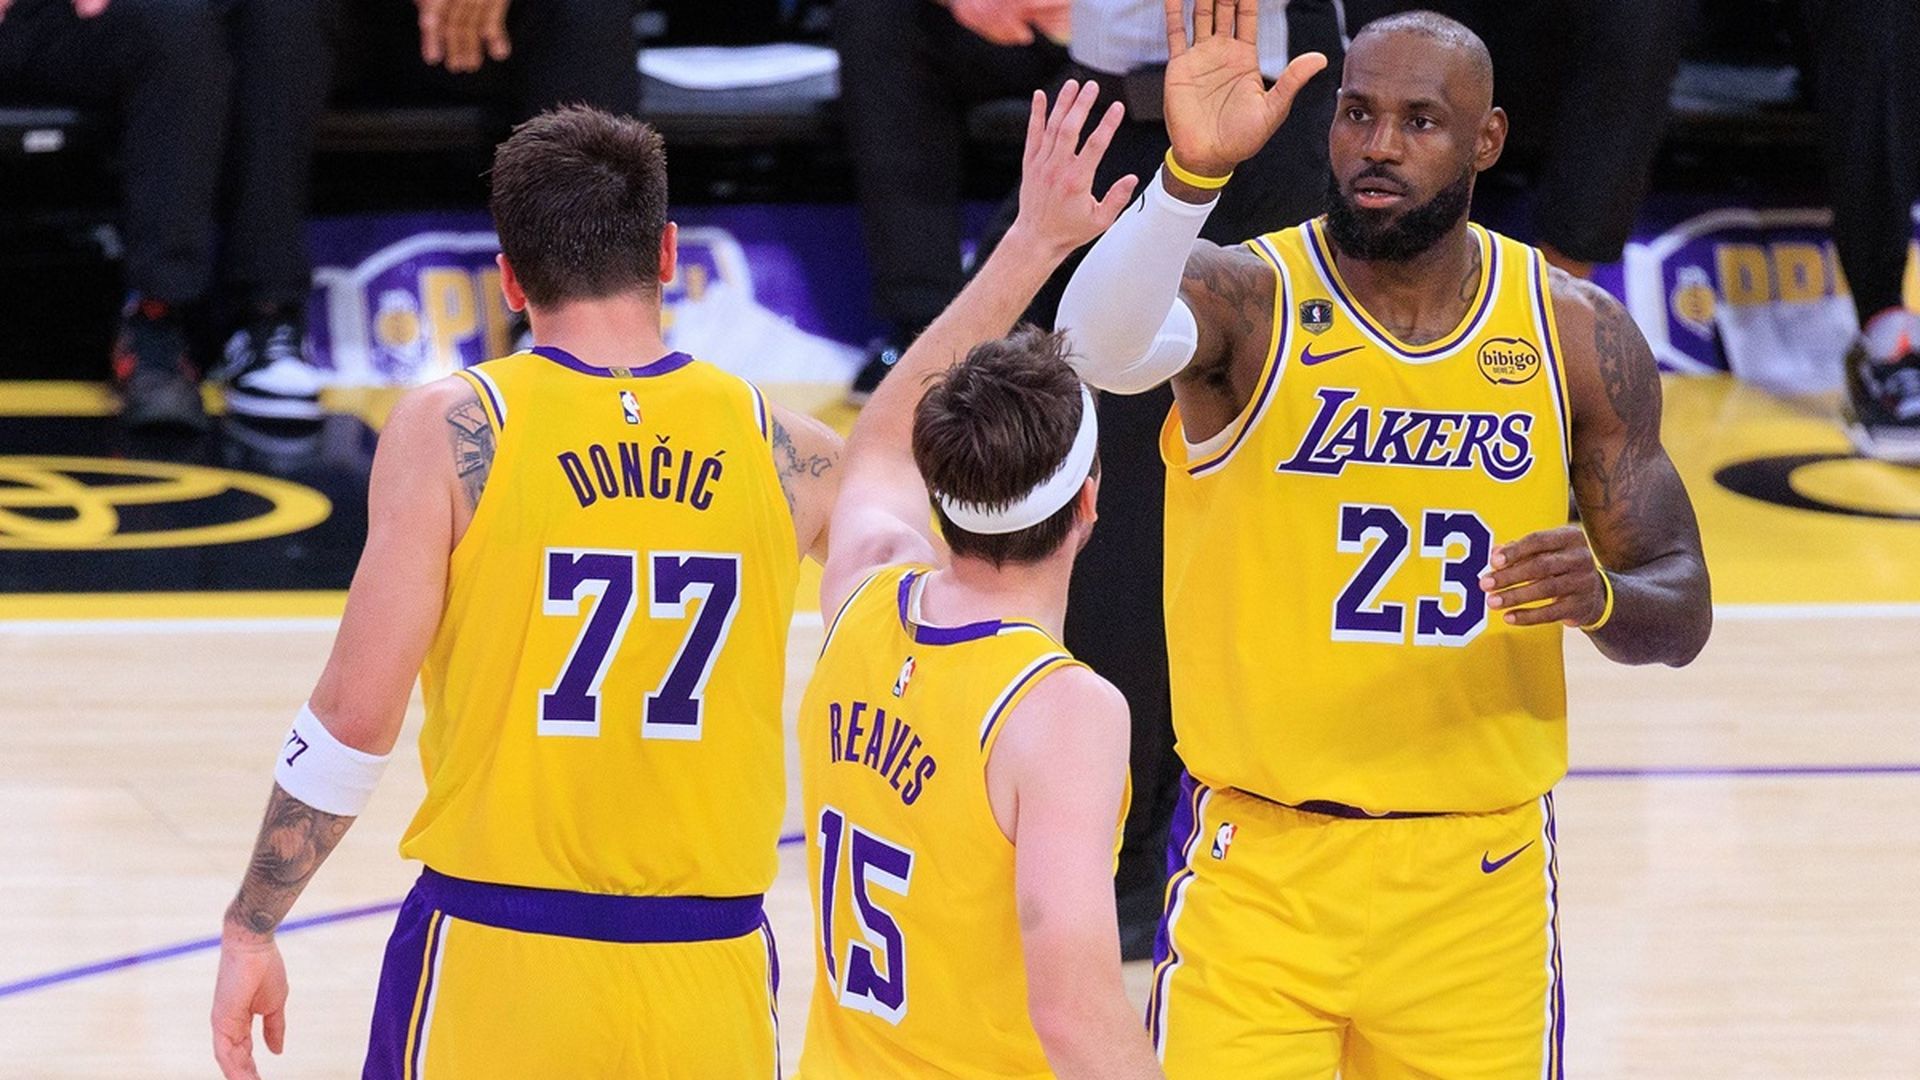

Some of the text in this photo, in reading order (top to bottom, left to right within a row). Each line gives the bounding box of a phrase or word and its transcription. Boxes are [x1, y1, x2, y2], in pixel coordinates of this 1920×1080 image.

[1483, 350, 1536, 371] bibigo
[558, 434, 726, 511] DONČIĆ
[1276, 388, 1535, 480] LAKERS
[1332, 503, 1493, 647] 23
[538, 548, 742, 740] 77
[829, 701, 937, 806] REAVES
[817, 804, 915, 1026] 15
